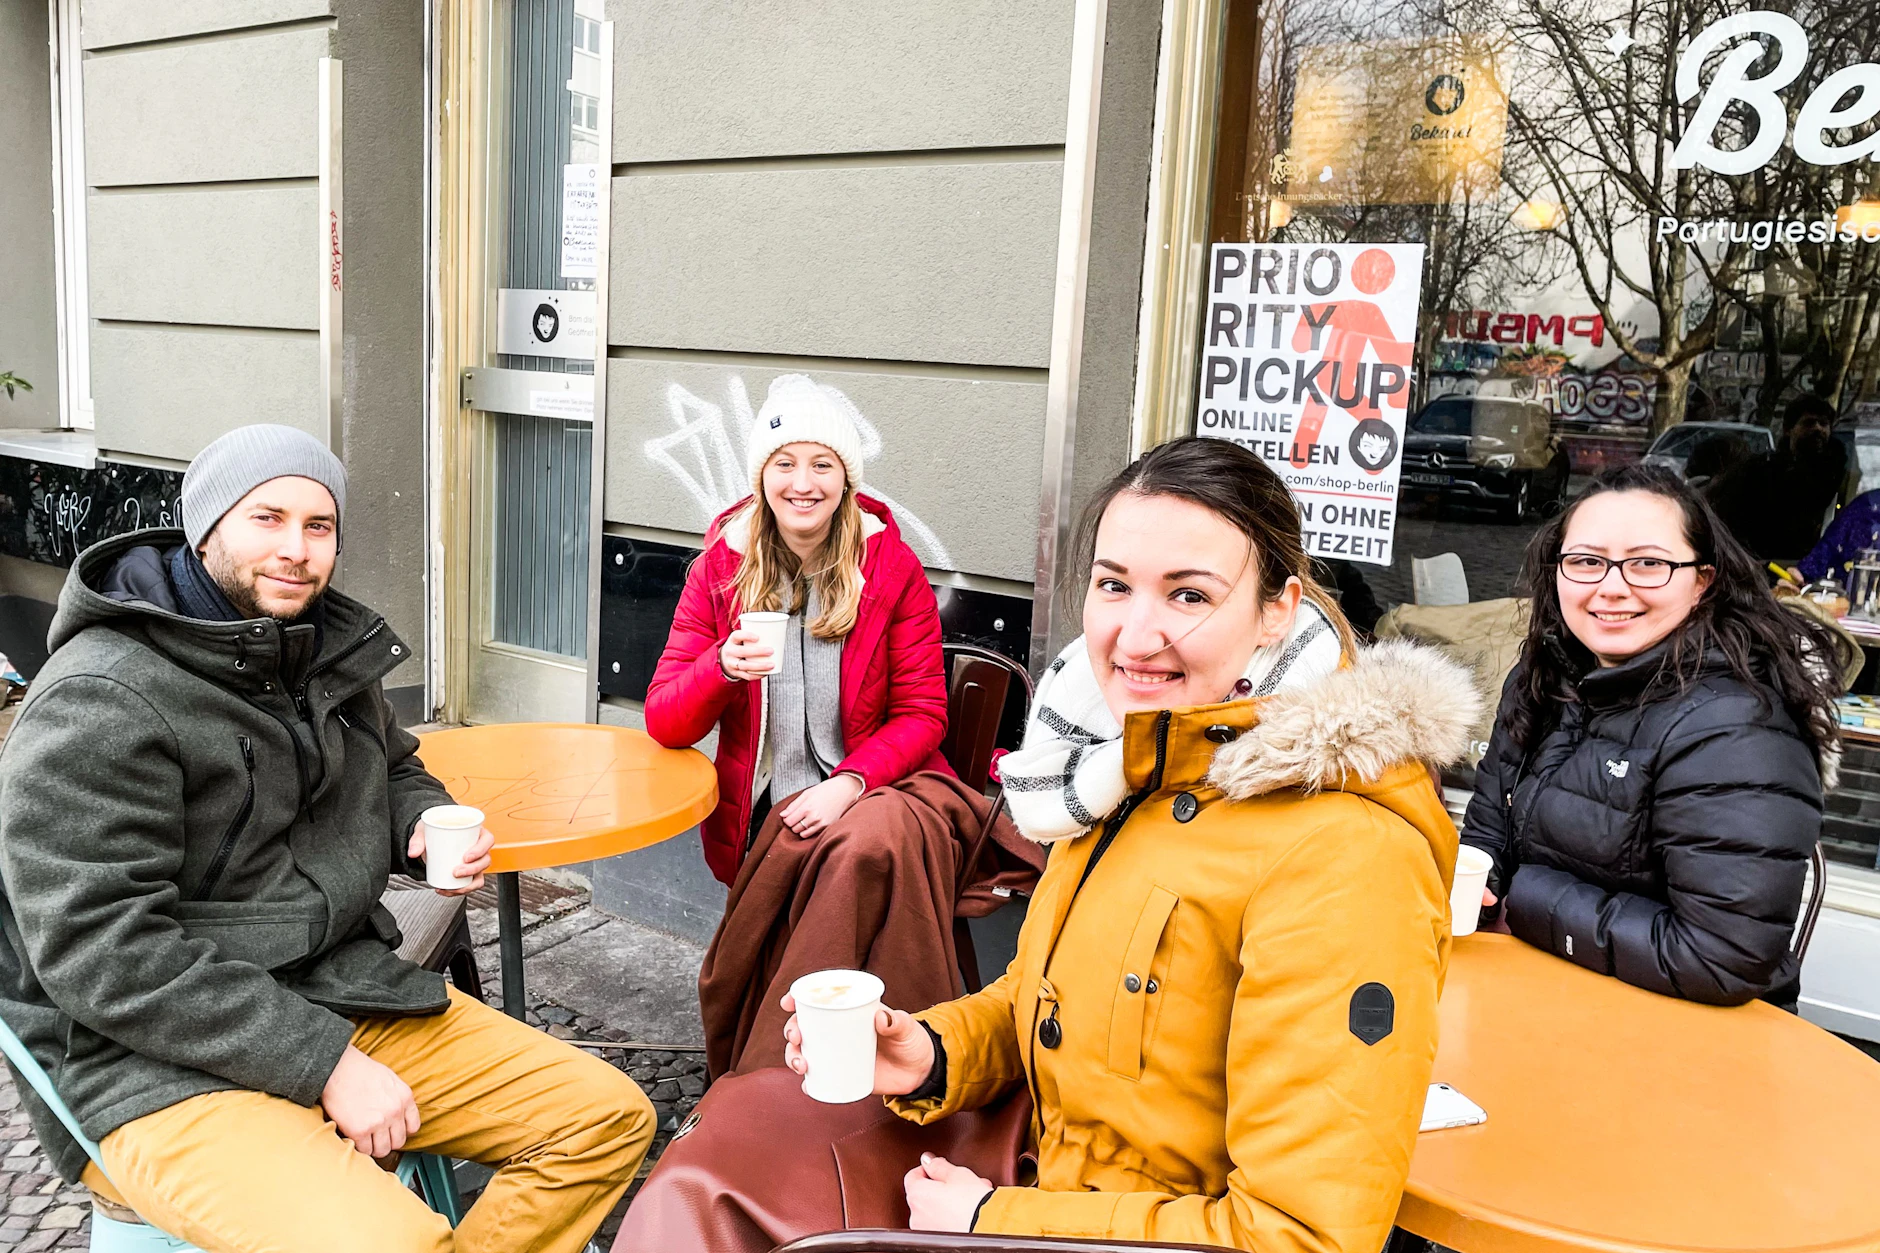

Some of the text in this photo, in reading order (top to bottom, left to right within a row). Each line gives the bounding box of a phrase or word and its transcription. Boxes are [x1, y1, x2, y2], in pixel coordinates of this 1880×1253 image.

[1668, 10, 1880, 176] Be
[1214, 248, 1342, 296] PRIO
[1209, 302, 1338, 351] RITY
[1204, 356, 1406, 409] PICKUP
[1202, 408, 1293, 433] ONLINE
[1201, 434, 1340, 465] TELLEN
[1321, 504, 1391, 530] OHNE
